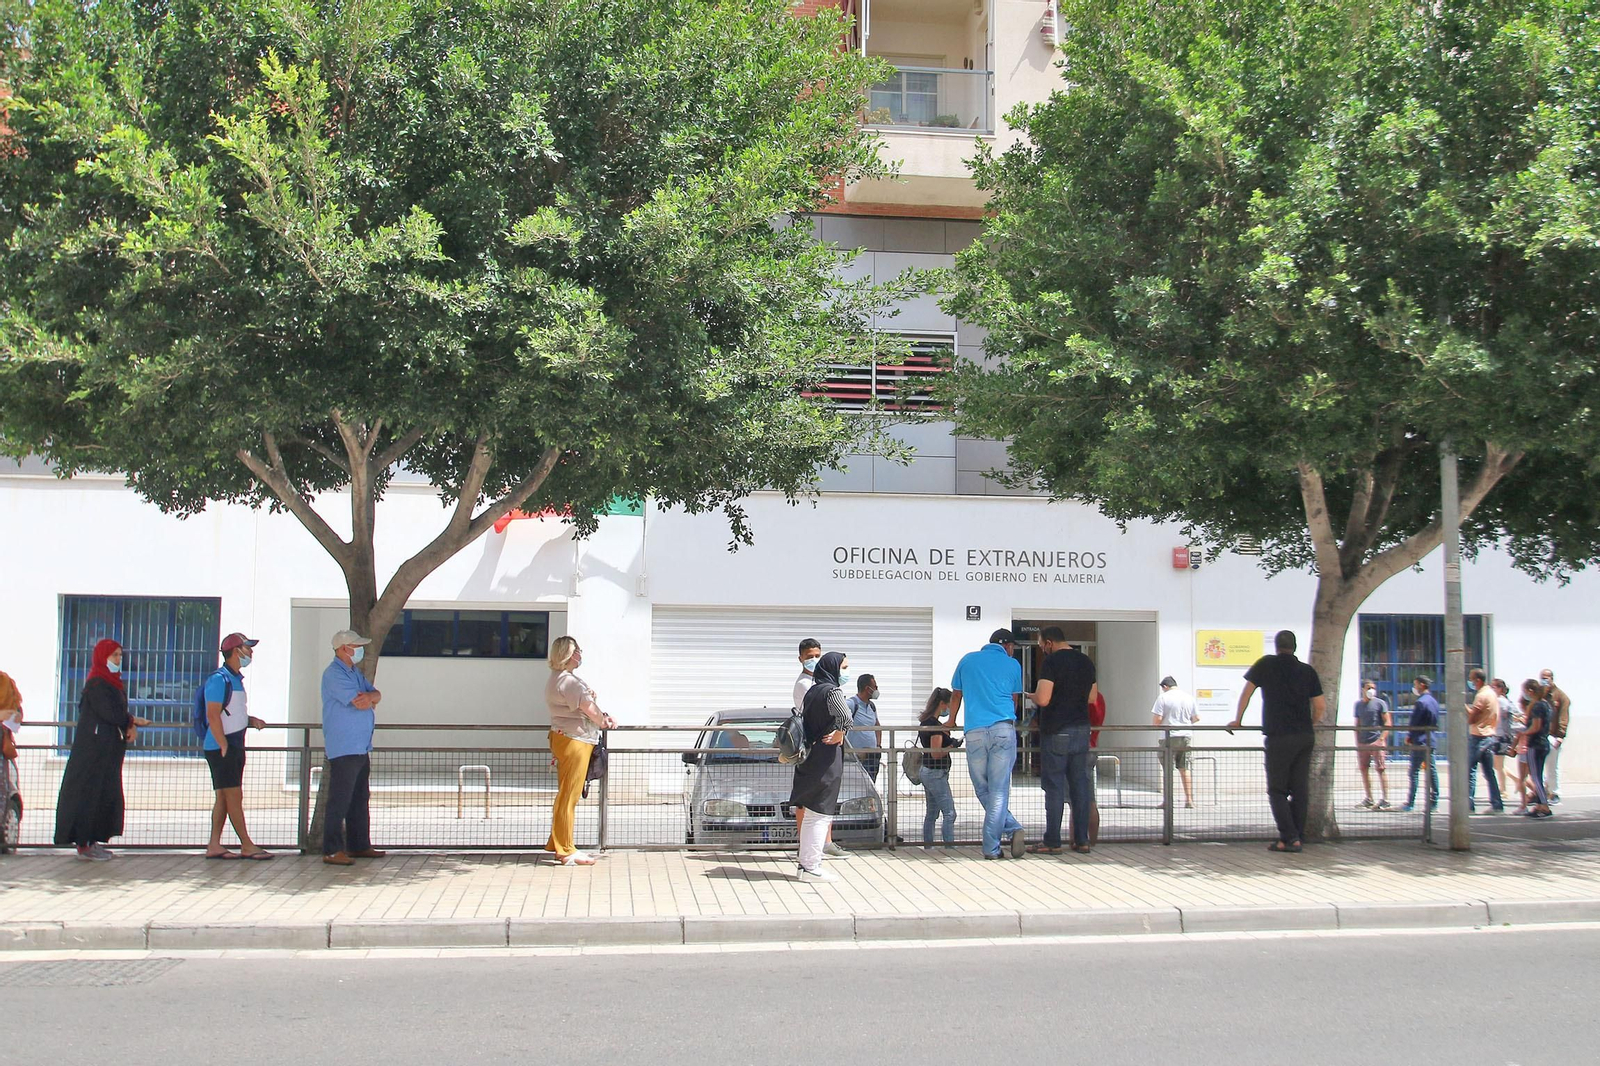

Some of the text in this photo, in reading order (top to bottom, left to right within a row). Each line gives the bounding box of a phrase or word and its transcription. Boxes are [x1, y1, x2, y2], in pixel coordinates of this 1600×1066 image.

[833, 547, 1107, 569] OFICINA DE EXTRANJEROS
[832, 569, 1105, 584] SUBDELEGACION DEL GOBIERNO EN ALMERIA
